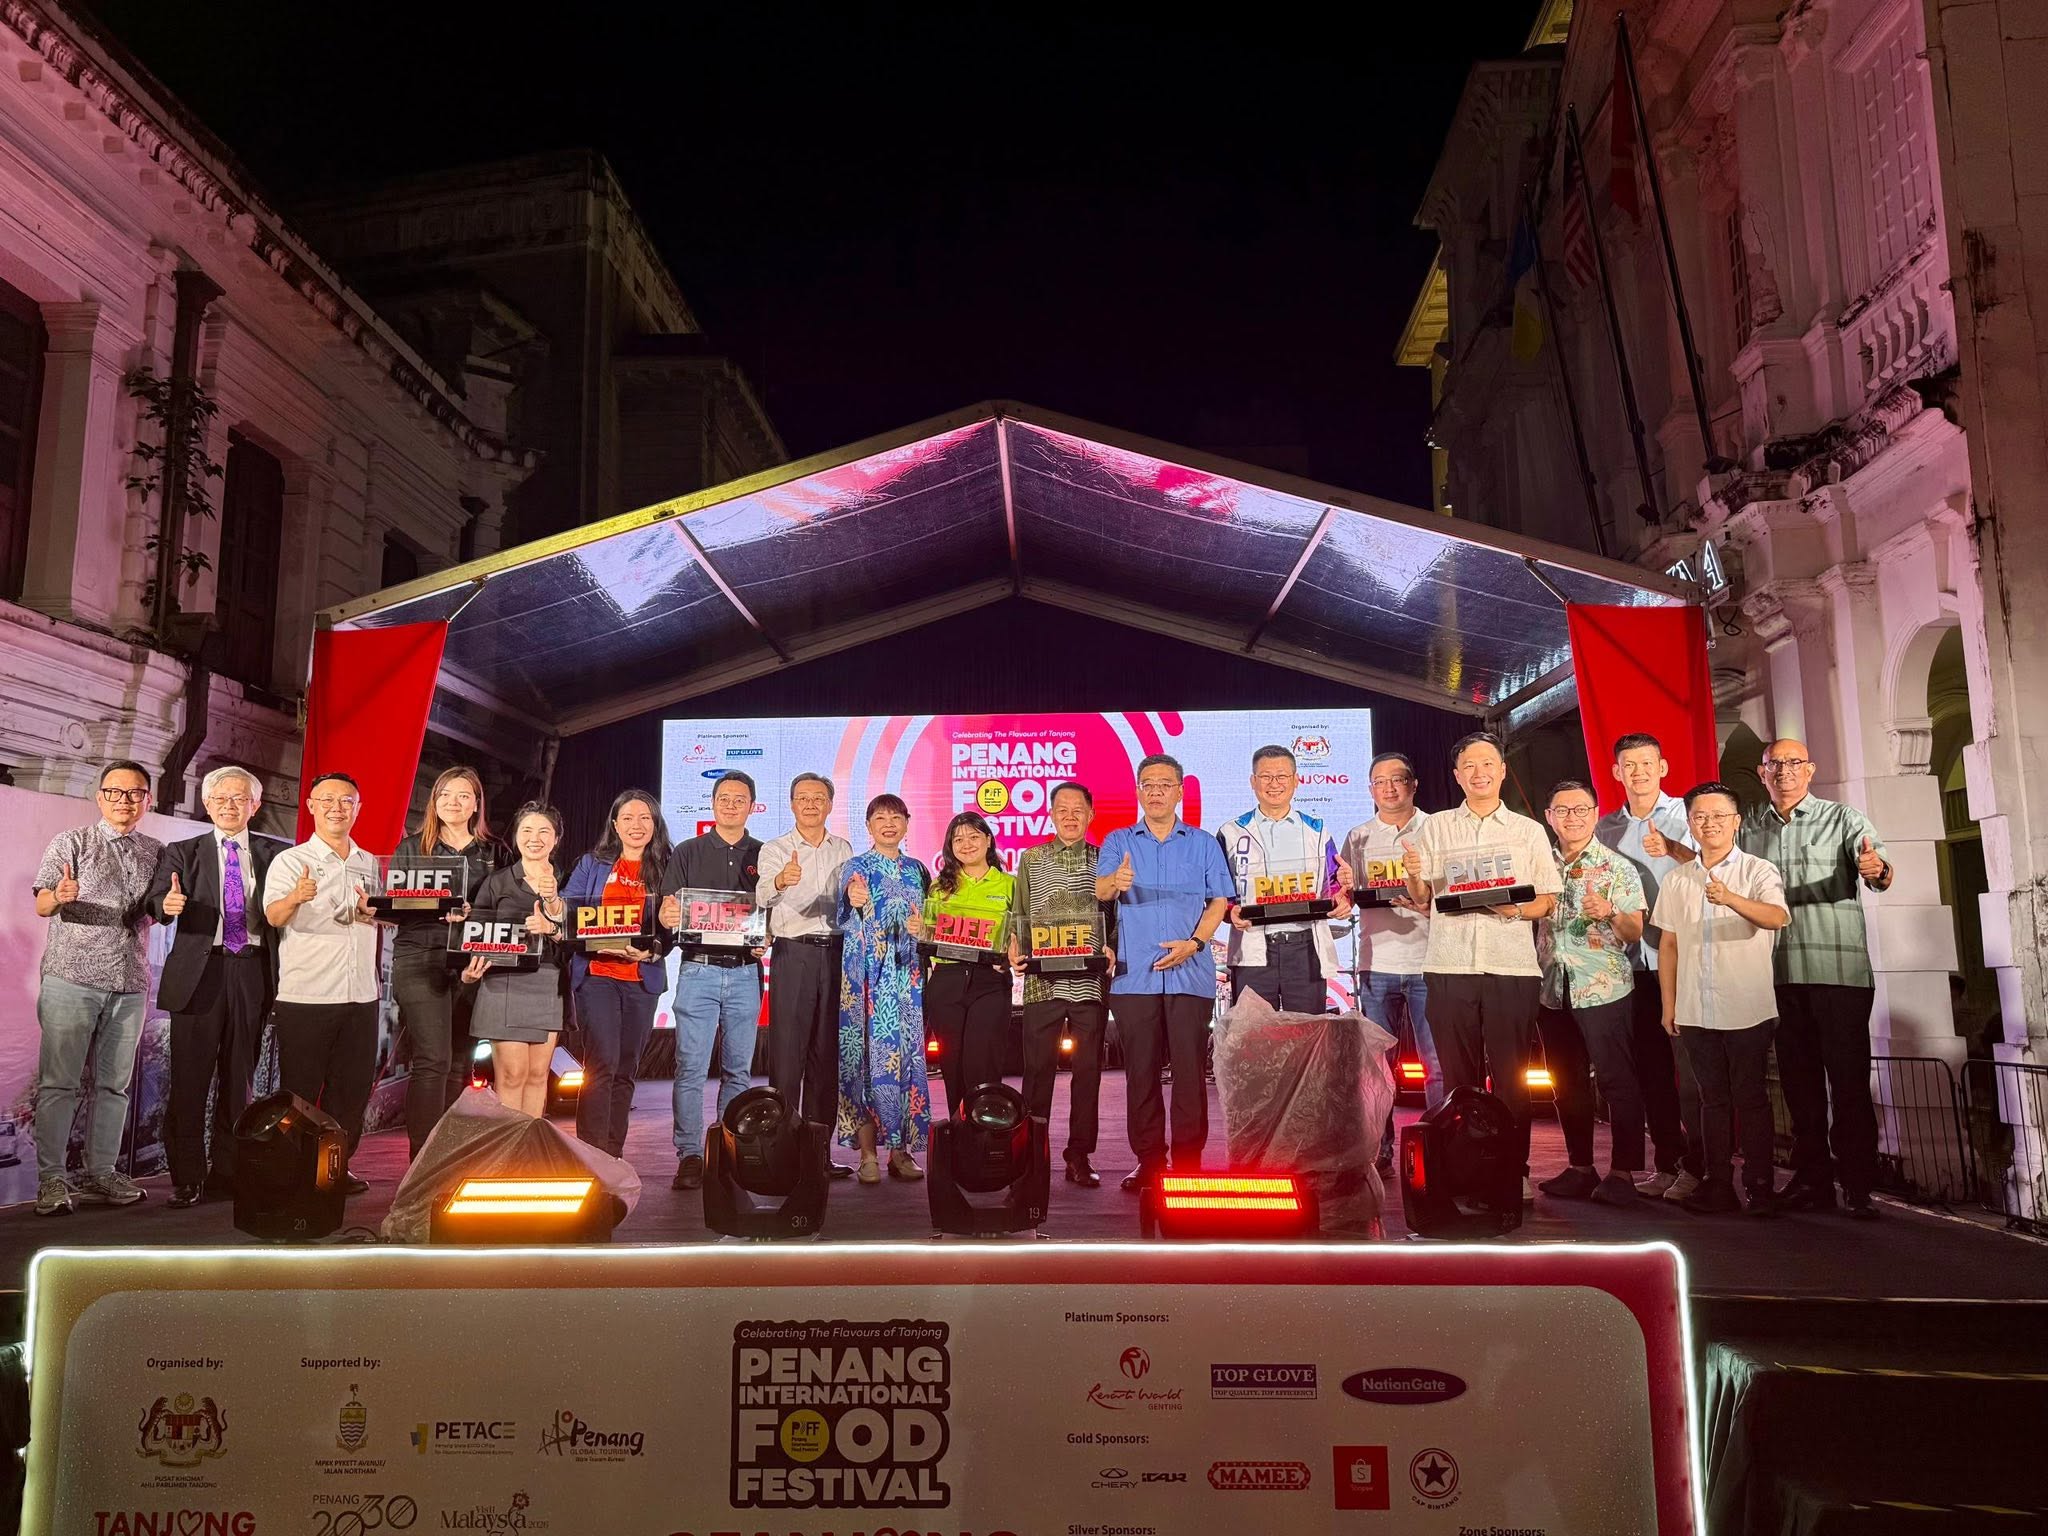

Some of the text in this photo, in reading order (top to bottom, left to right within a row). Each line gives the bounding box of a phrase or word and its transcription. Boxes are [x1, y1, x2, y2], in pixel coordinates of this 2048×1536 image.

[952, 731, 993, 740] Celebrating
[1008, 730, 1038, 738] Flavours
[1048, 729, 1076, 739] Tanjong
[952, 741, 1077, 765] PENANG
[952, 765, 1077, 779] INTERNATIONAL
[1444, 853, 1513, 885] PIFF
[387, 870, 452, 890] PIFF
[1254, 872, 1315, 897] PIFF
[577, 904, 641, 929] PIFF
[690, 902, 751, 924] PIFF
[463, 921, 527, 944] PIFF
[935, 914, 995, 939] PIFF
[1031, 925, 1091, 948] PIFF
[1029, 1207, 1040, 1219] 19
[1065, 1312, 1169, 1325] Platinum Sponsors:
[740, 1326, 942, 1341] Celebrating The Flavours of Tanjong
[146, 1357, 223, 1371] Organised by:
[300, 1357, 381, 1371] Supported by:
[738, 1347, 943, 1383] PENANG
[1213, 1368, 1315, 1383] TOP GLOVE
[1362, 1377, 1446, 1392] NationGate
[738, 1385, 943, 1405] INTERNATIONAL
[1147, 1403, 1183, 1411] GENTING
[435, 1421, 515, 1440] PETACE
[570, 1418, 645, 1456] Penang
[1067, 1433, 1150, 1446] Gold Sponsors:
[737, 1468, 943, 1500] FESTIVAL
[1219, 1469, 1300, 1484] MAMEE
[1091, 1481, 1138, 1489] CHERY
[312, 1494, 360, 1505] PENANG
[1411, 1495, 1460, 1511] CAP BINTANG
[1068, 1524, 1156, 1536] Silver Sponsors:
[1459, 1526, 1546, 1536] Zone Sponsors:
